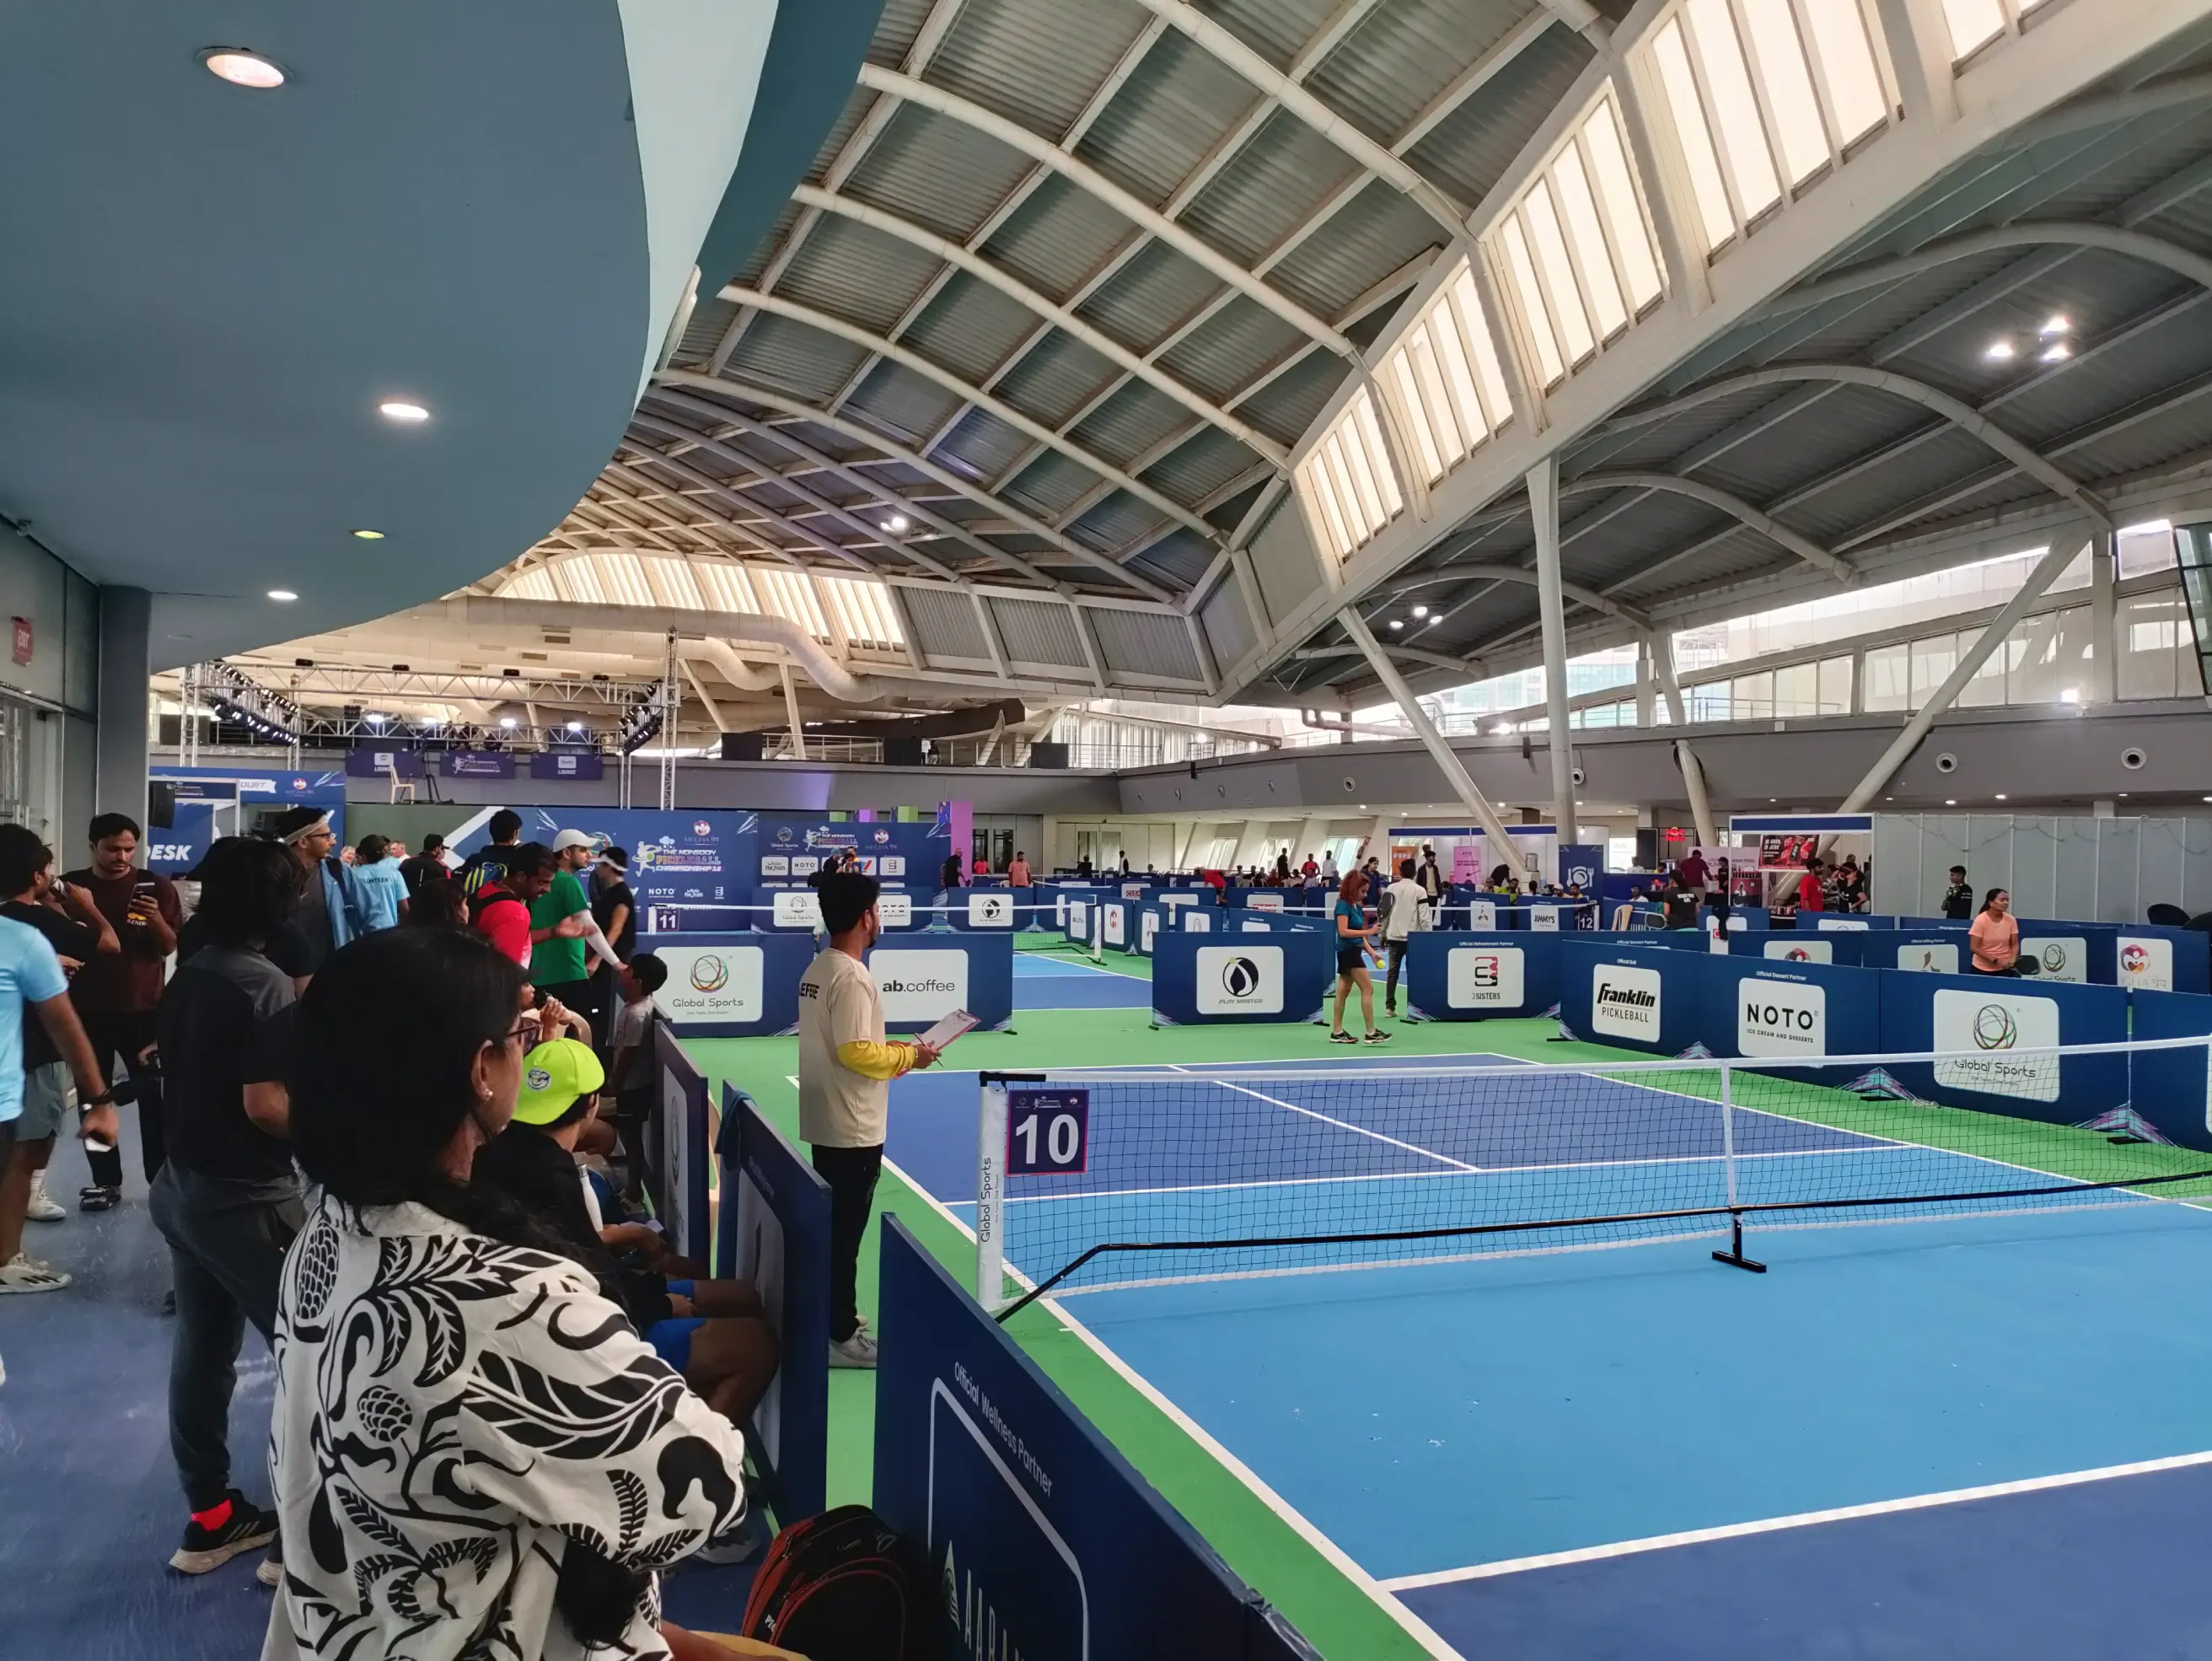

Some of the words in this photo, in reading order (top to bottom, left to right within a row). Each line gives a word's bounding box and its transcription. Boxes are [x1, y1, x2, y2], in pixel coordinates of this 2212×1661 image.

[659, 914, 676, 928] 11
[1580, 917, 1593, 929] 12
[882, 979, 955, 992] ab.coffee
[672, 998, 705, 1007] Global
[708, 997, 744, 1008] Sports
[1602, 1007, 1649, 1023] PICKLEBALL
[1747, 1003, 1813, 1030] NOTO
[1789, 1035, 1814, 1043] DESSERTS
[1955, 1059, 1990, 1072] Global
[1995, 1062, 2036, 1078] Sports
[1015, 1114, 1079, 1164] 10
[980, 1157, 993, 1200] Sports
[980, 1204, 991, 1243] Global
[954, 1361, 980, 1406] Official
[981, 1392, 1017, 1454] Wellness
[1018, 1438, 1053, 1498] Partner
